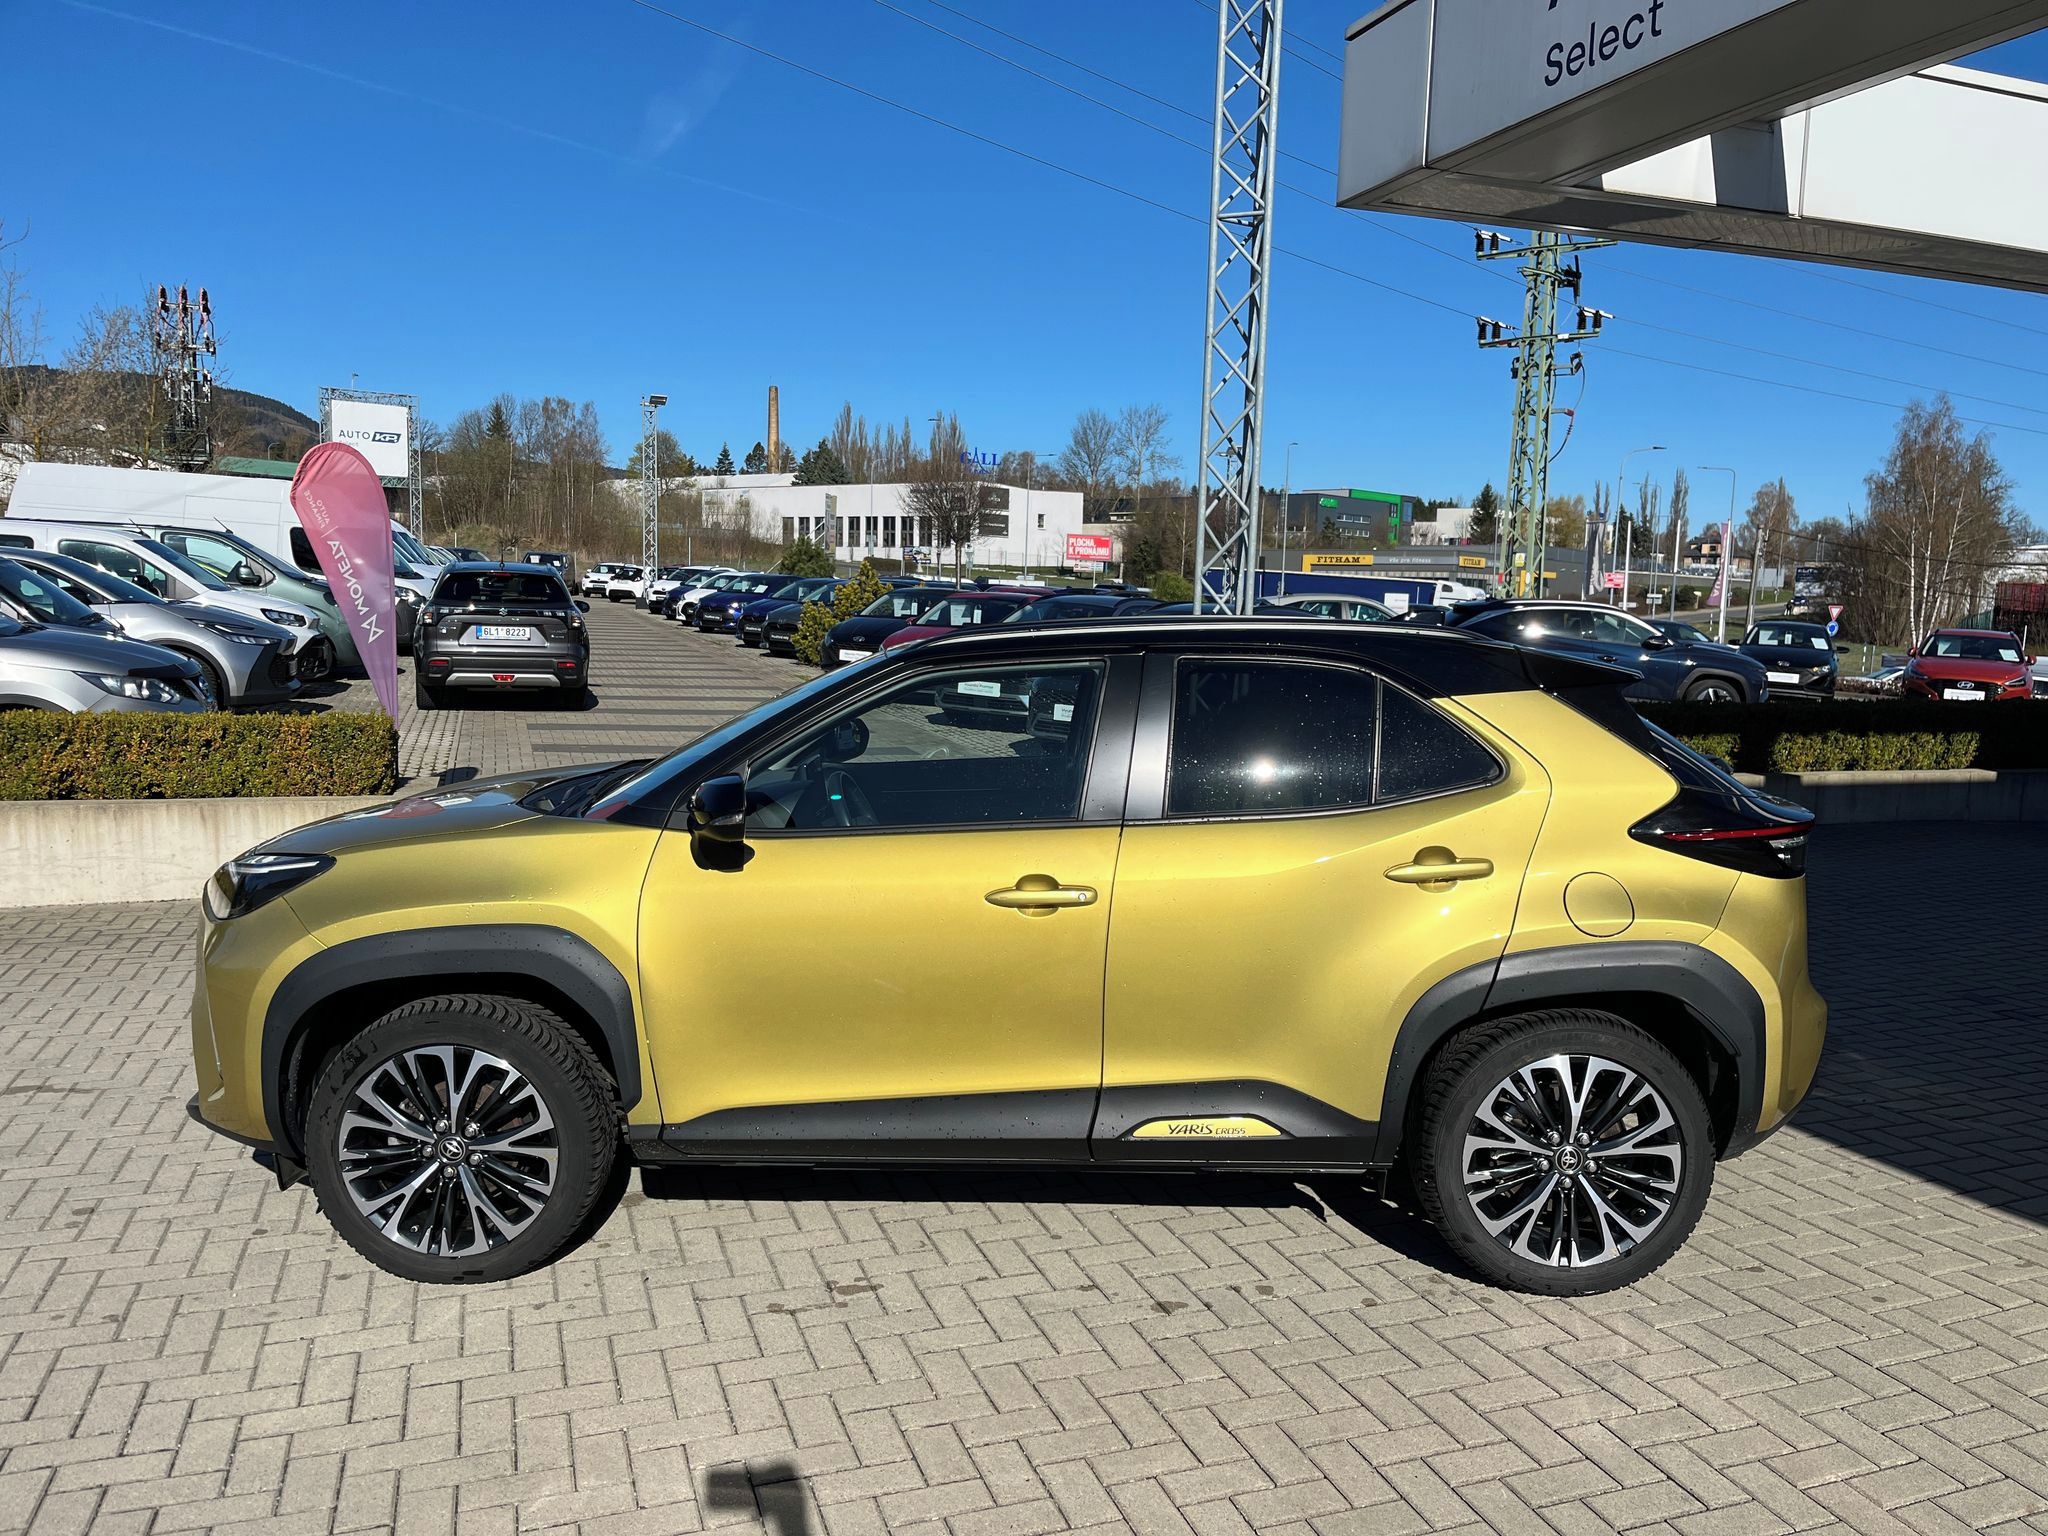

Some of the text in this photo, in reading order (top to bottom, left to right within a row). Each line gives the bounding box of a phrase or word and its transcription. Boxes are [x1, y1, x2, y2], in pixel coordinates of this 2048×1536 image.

[1544, 0, 1664, 87] Select
[338, 430, 370, 440] AUTO
[483, 627, 527, 637] 6L1 8223
[1215, 1127, 1246, 1135] CROSS
